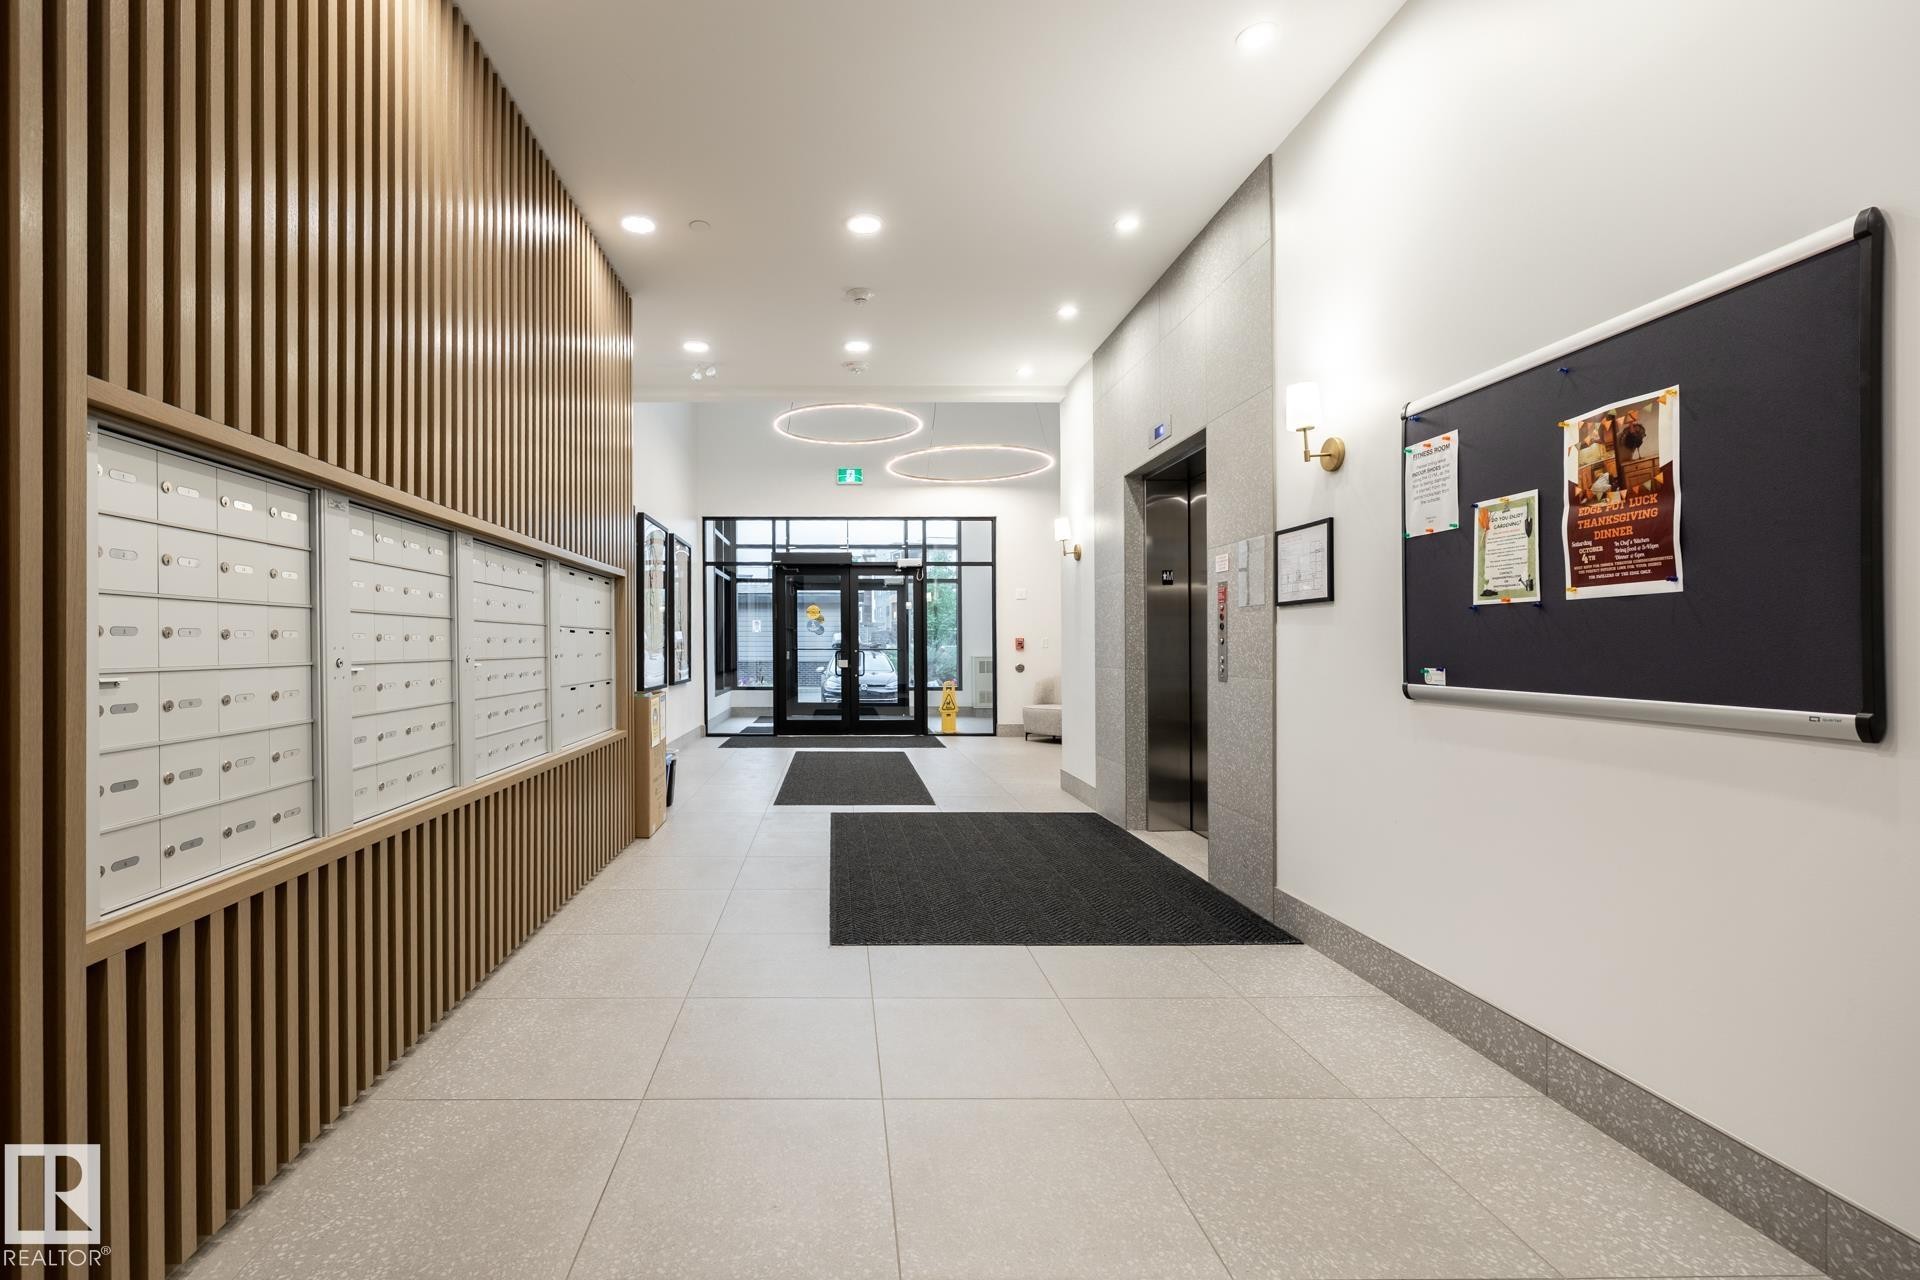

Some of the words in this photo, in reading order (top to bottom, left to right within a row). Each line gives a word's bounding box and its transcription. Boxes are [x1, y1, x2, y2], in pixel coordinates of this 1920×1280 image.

[1413, 449, 1433, 460] FITNESS
[1434, 443, 1450, 453] ROOM
[1578, 504, 1602, 517] EDGE
[1606, 501, 1626, 512] POT
[1629, 493, 1658, 508] LUCK
[1509, 512, 1523, 520] ENJOY
[1577, 507, 1659, 529] THANKSGIVING
[1594, 525, 1634, 540] DINNER
[1578, 546, 1603, 554] OCTOBER
